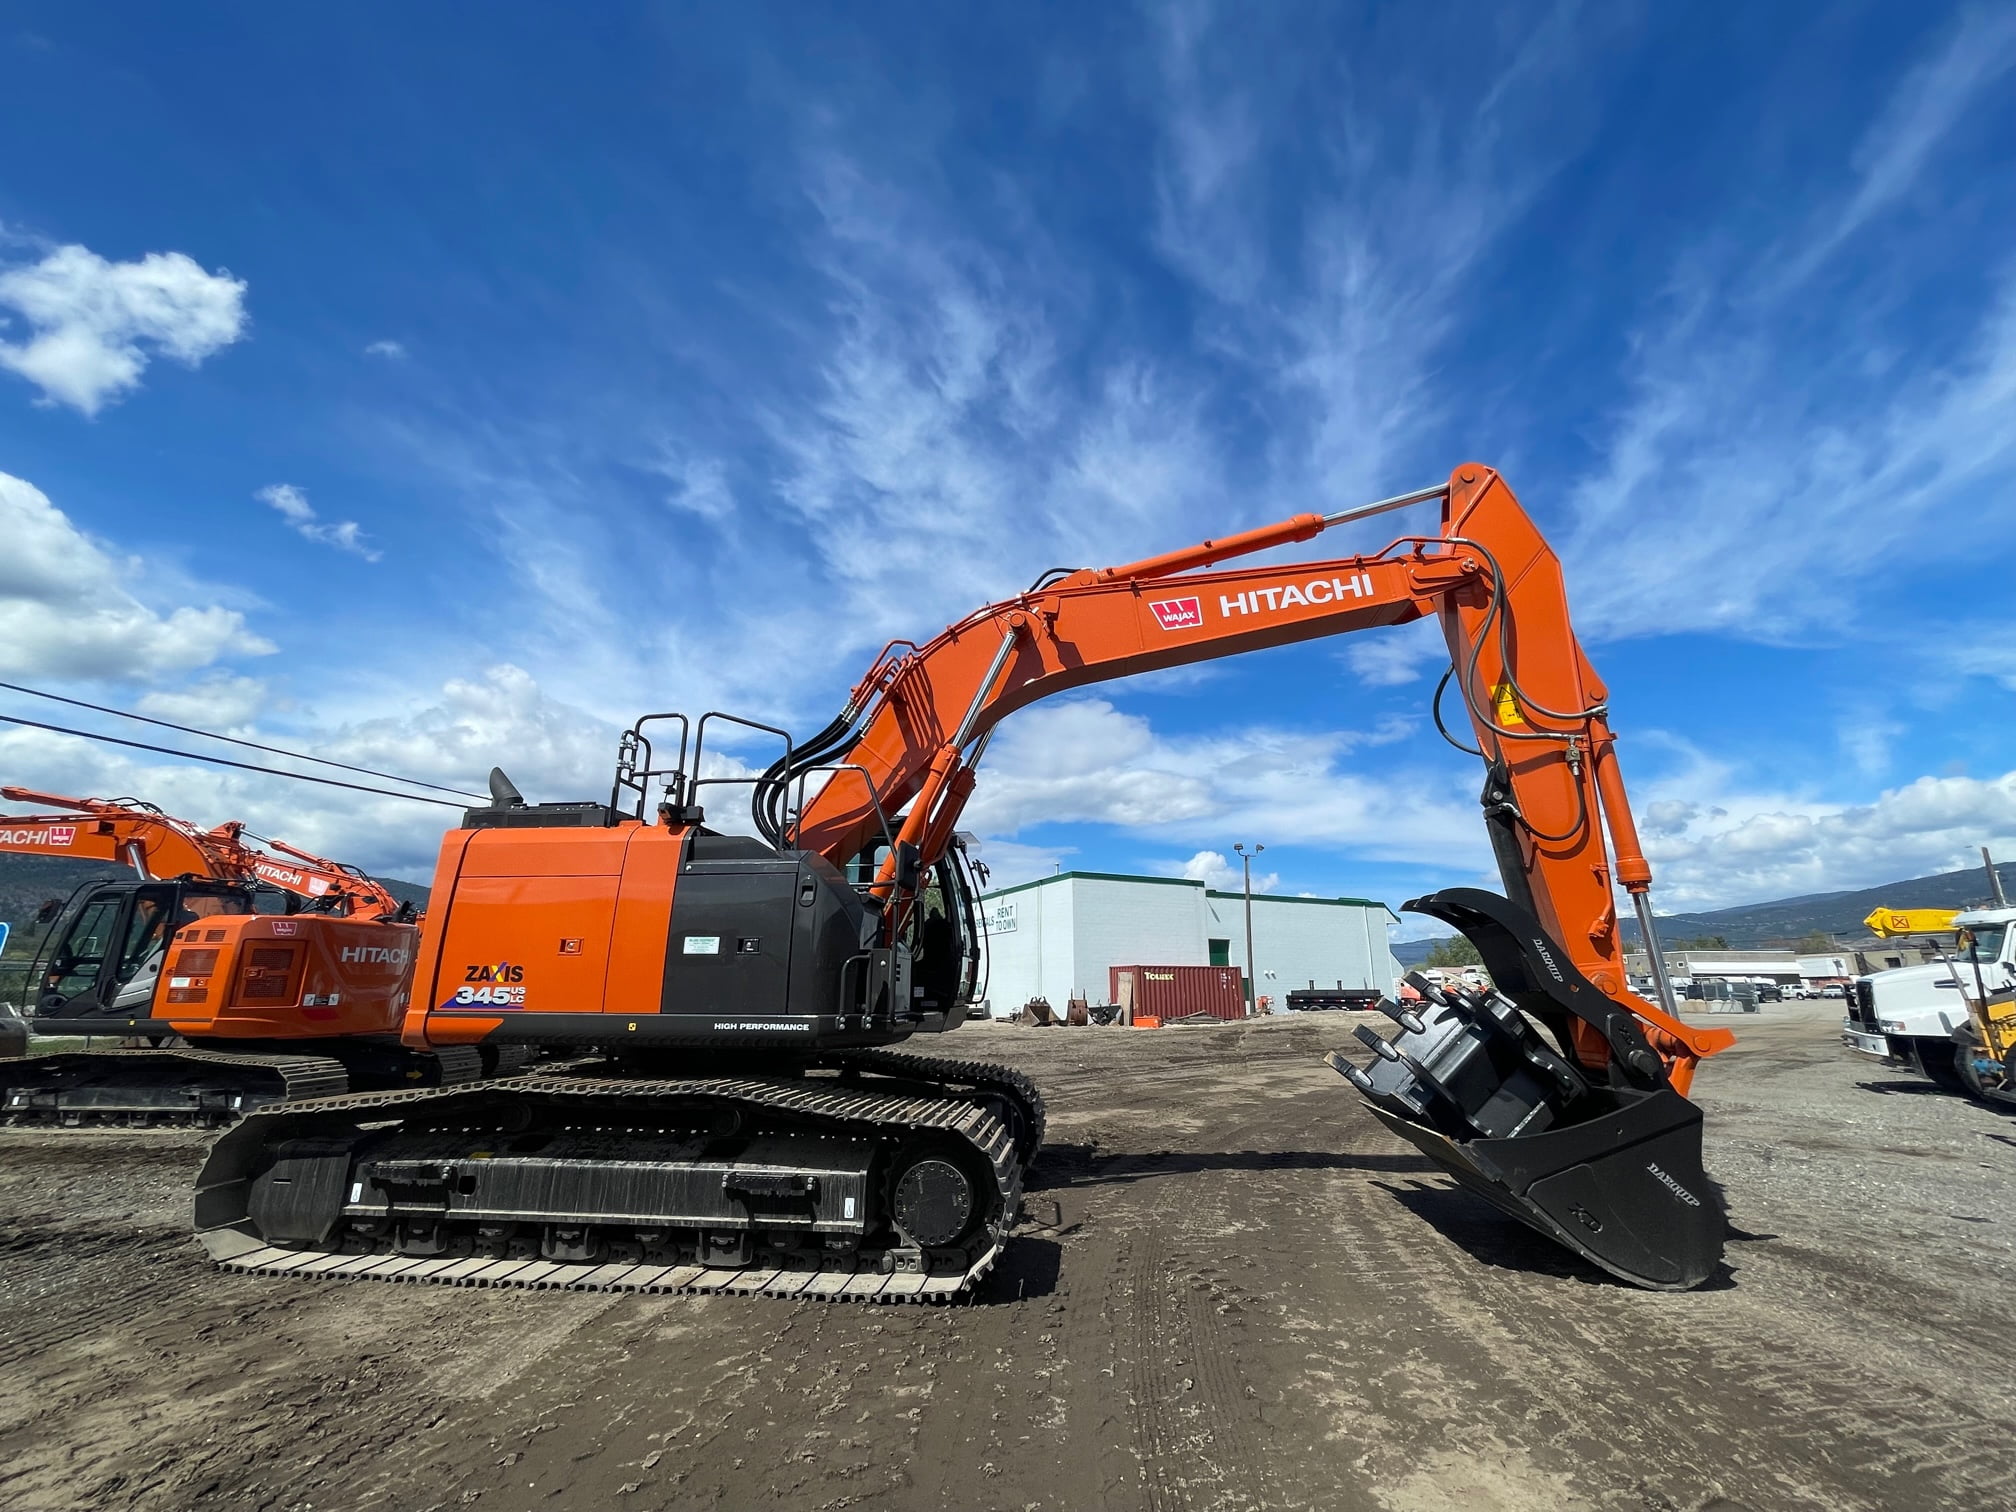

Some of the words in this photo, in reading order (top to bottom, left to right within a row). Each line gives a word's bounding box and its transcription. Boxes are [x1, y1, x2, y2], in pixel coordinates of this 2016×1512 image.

[1219, 573, 1375, 618] HITACHI
[1163, 611, 1196, 622] WAJAX
[255, 863, 302, 885] HITACHI
[997, 905, 1014, 918] RENT
[1531, 939, 1564, 982] DAEQUIP
[465, 961, 524, 983] ZAXIS
[455, 986, 511, 1005] 345
[510, 995, 525, 1003] LC
[511, 986, 526, 995] US
[714, 1022, 738, 1030] HIGH
[740, 1023, 810, 1031] PERFORMANCE
[1645, 1162, 1701, 1207] DAEQUIP
